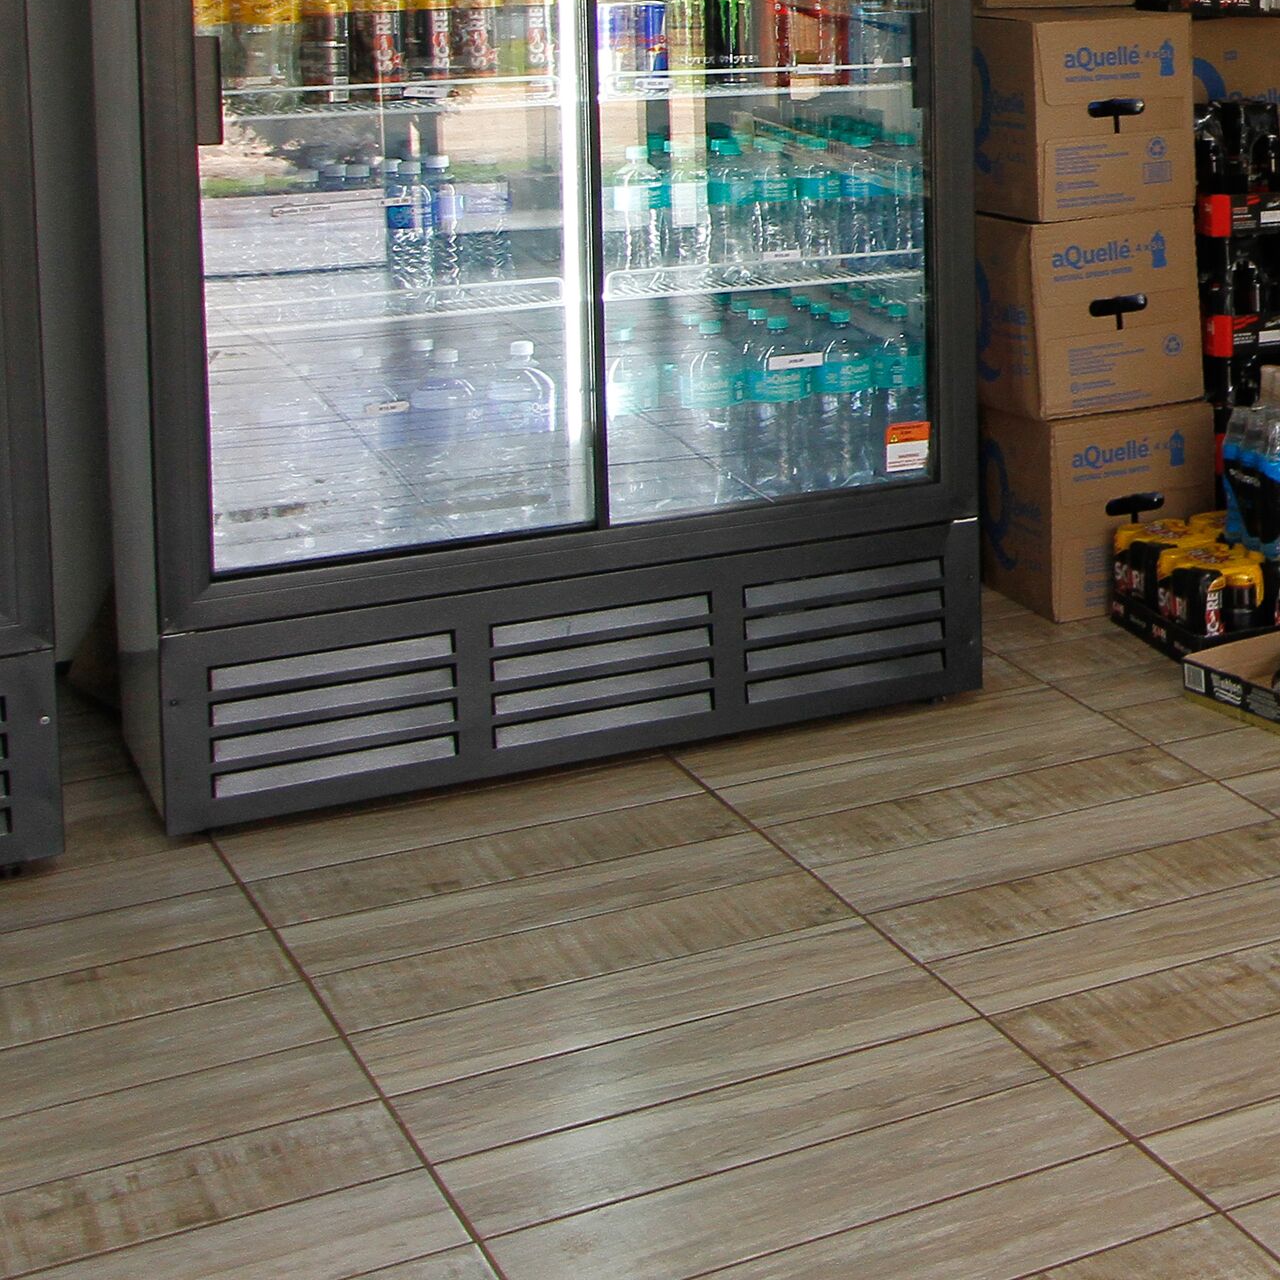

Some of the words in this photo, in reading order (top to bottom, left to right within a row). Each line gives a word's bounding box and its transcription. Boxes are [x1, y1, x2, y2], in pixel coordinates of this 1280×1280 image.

[1064, 45, 1140, 70] aQuellé
[1052, 239, 1133, 269] aQuellé
[1072, 437, 1149, 469] aQuellé
